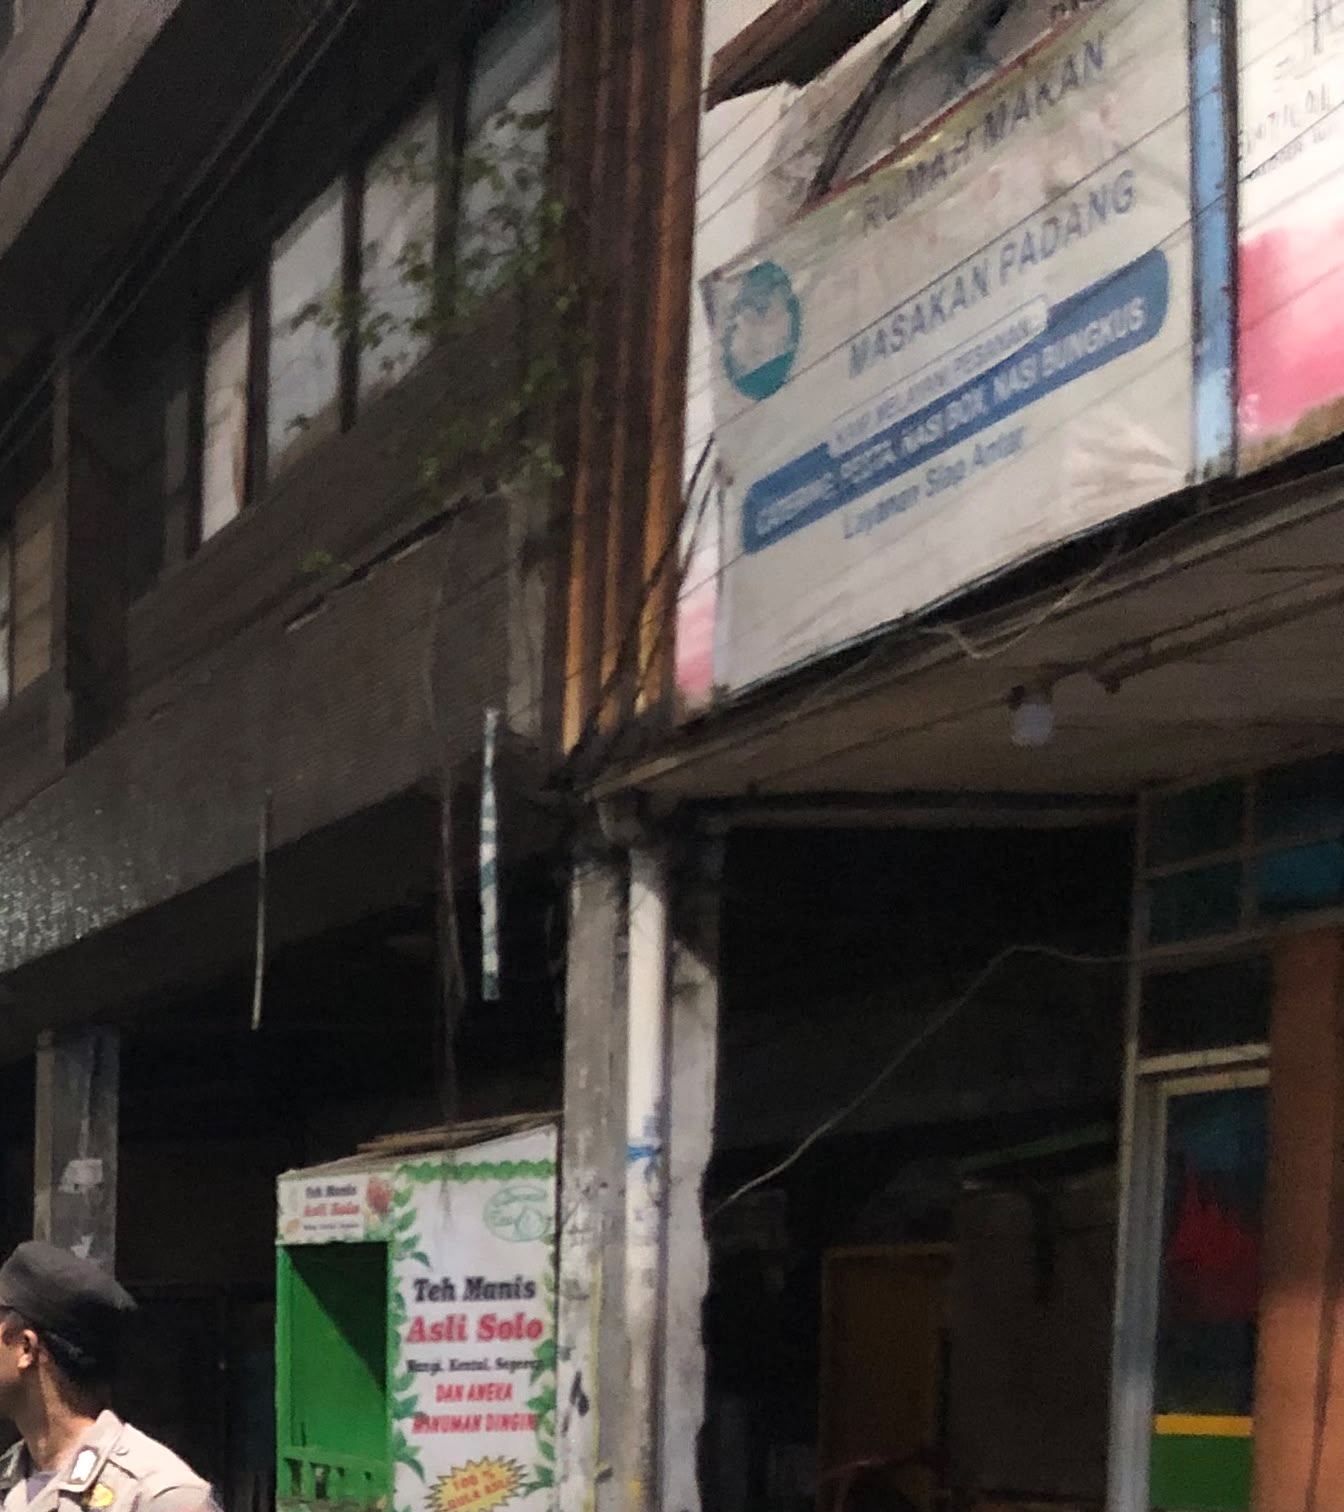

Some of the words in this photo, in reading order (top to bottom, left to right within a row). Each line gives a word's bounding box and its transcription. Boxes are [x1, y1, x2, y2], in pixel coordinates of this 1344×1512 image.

[983, 32, 1106, 142] MAKAN
[849, 256, 991, 379] MASAKAN
[998, 169, 1138, 284] PADANG
[992, 356, 1038, 402] NASI
[1040, 296, 1145, 379] BUNGKUS
[414, 1277, 456, 1302] Teh
[463, 1274, 537, 1302] Manis
[406, 1313, 468, 1344] Asli
[477, 1312, 544, 1342] Solo
[435, 1384, 464, 1403] DAN
[467, 1383, 515, 1402] ANEKA
